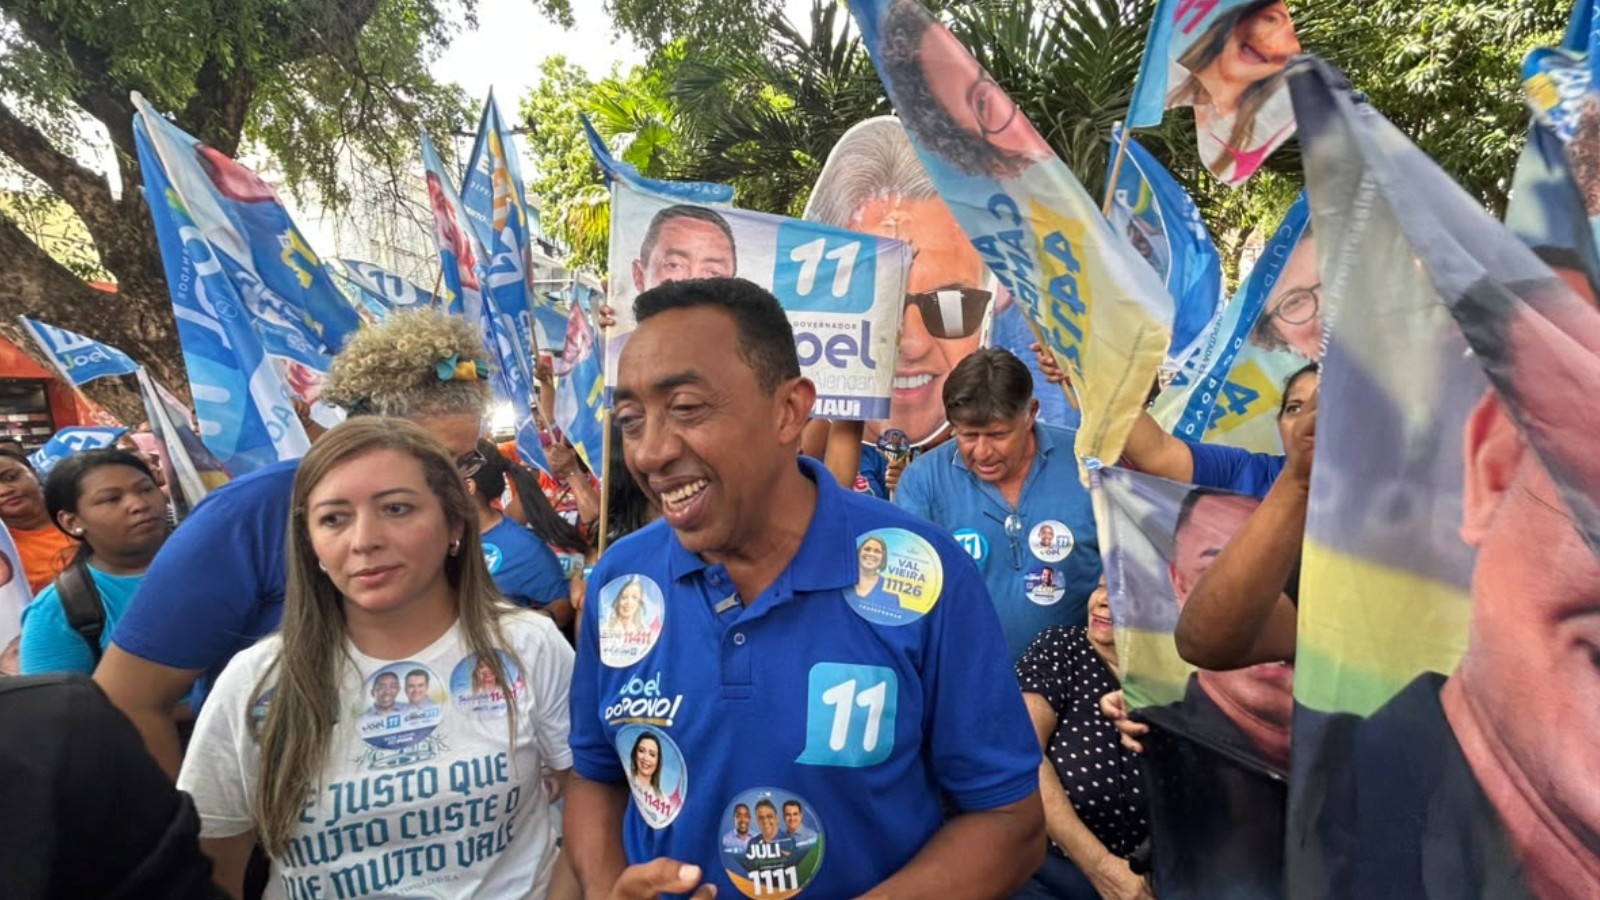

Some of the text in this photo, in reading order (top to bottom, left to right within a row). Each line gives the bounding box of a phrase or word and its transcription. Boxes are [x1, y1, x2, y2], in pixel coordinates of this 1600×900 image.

[790, 237, 861, 297] 11
[793, 320, 857, 330] GOVERNADOR
[793, 319, 876, 369] oel
[1185, 377, 1217, 435] POVO
[888, 565, 926, 583] VIEIRA
[898, 559, 919, 571] VAL
[886, 578, 923, 597] 11126
[620, 672, 661, 697] Joel
[361, 719, 384, 731] Joel
[822, 679, 886, 752] 11
[325, 766, 439, 827] JUSTO
[449, 752, 509, 796] QUE
[643, 791, 671, 817] 11411
[282, 786, 521, 869] MUITO CUSTE O
[330, 843, 446, 900] MUITO
[455, 815, 517, 868] VALE
[747, 865, 799, 896] 1111
